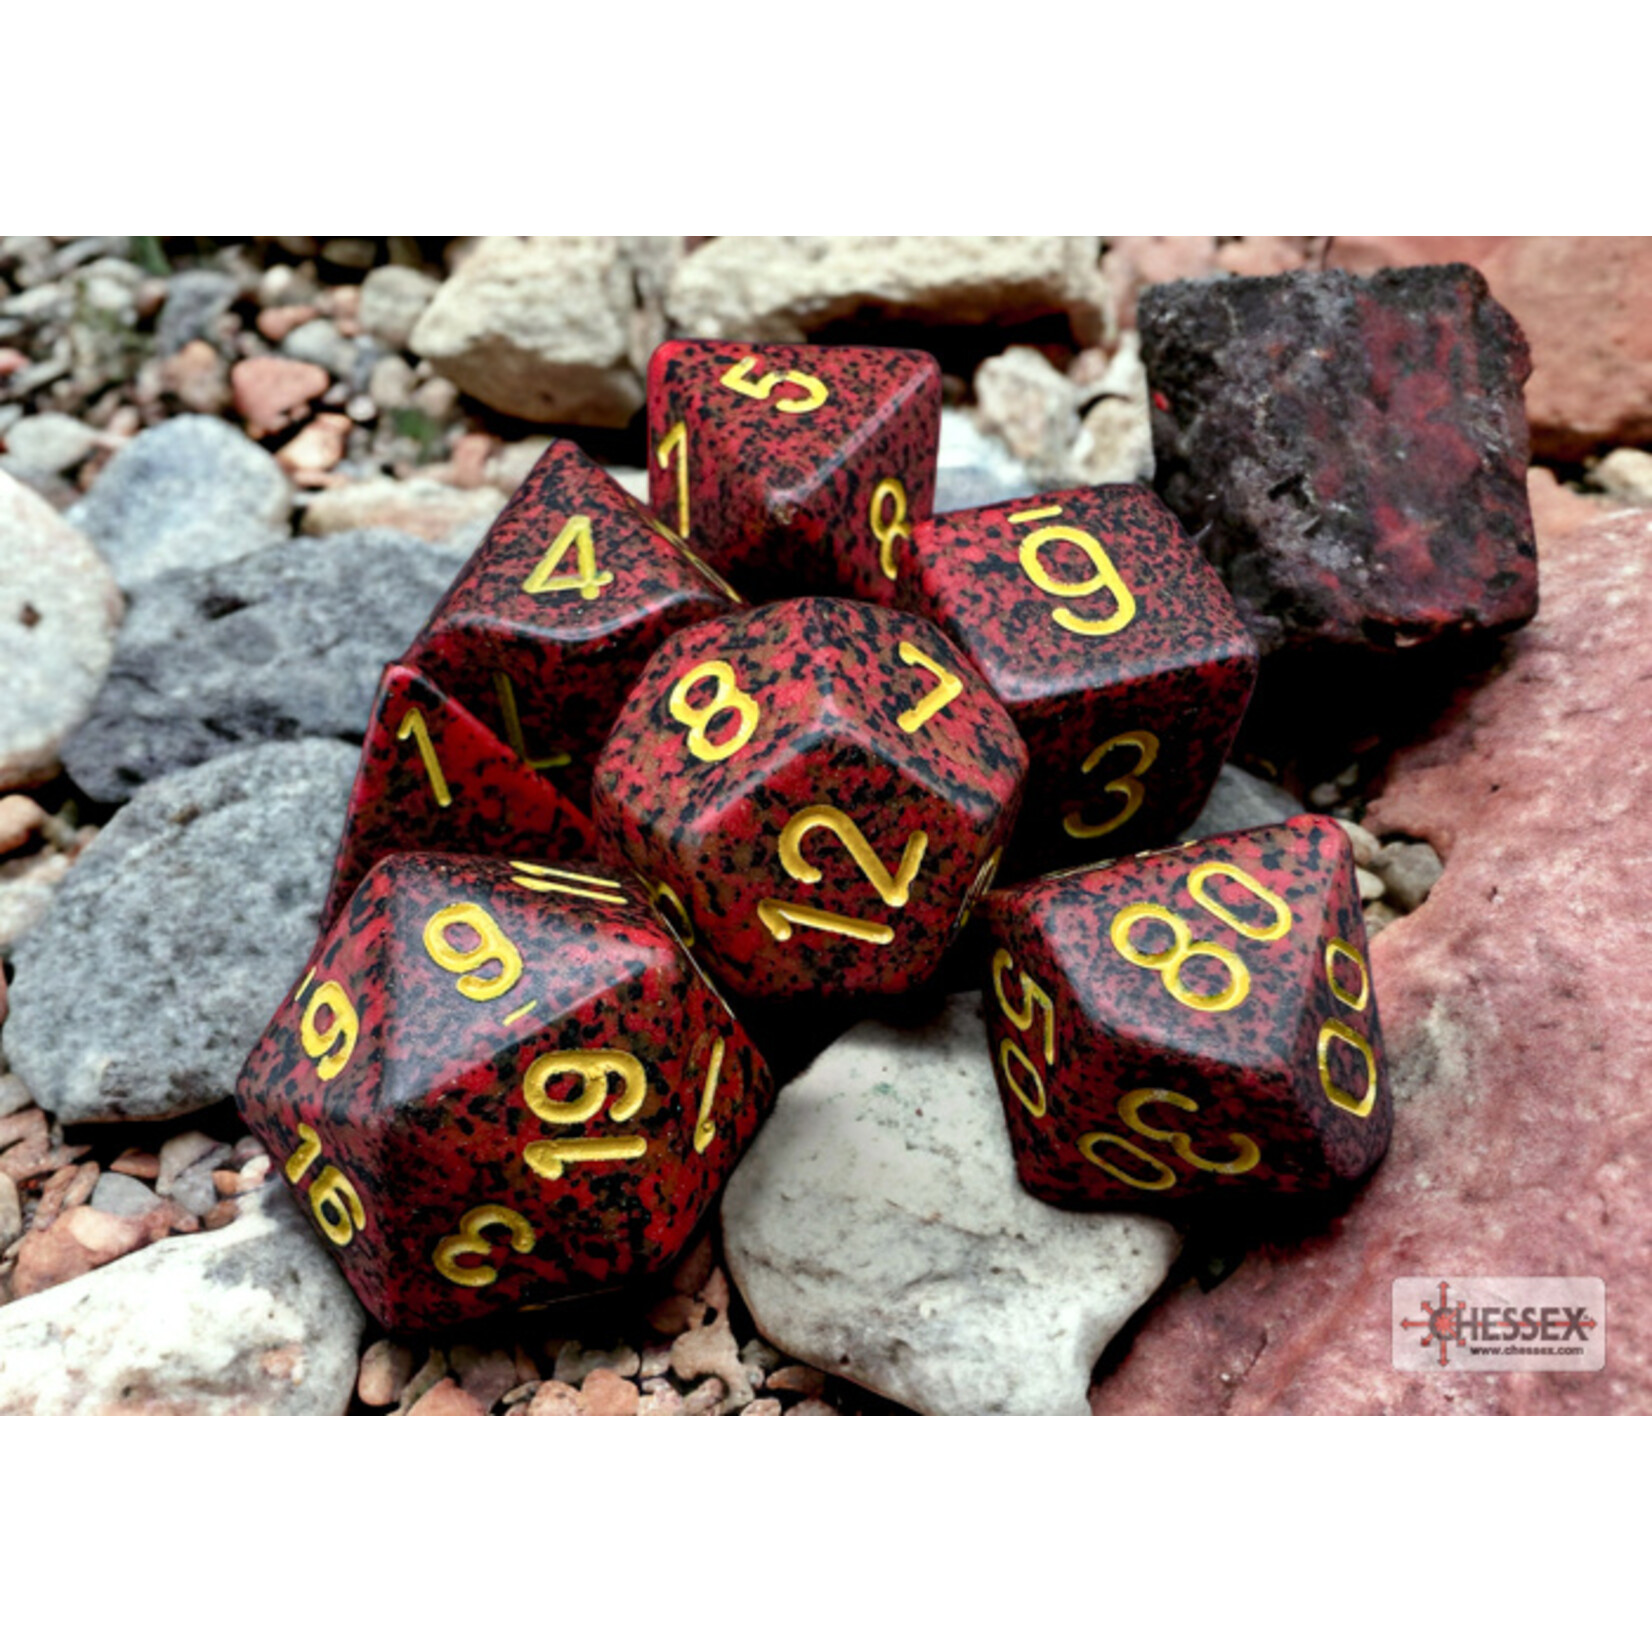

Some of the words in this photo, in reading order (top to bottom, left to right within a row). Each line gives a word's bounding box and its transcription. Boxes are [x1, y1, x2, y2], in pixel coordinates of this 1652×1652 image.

[720, 357, 829, 413] 5
[523, 515, 614, 600] 4
[398, 707, 453, 807] 1
[670, 660, 760, 762] 8
[1063, 730, 1160, 838] 3
[757, 804, 929, 945] 12
[424, 901, 536, 1026] 9
[1110, 861, 1292, 1012] 80
[992, 949, 1055, 1119] 50
[1317, 937, 1379, 1118] 00
[523, 1048, 647, 1180] 19
[1077, 1088, 1261, 1190] 30
[285, 1123, 367, 1247] 16
[432, 1204, 536, 1287] 3
